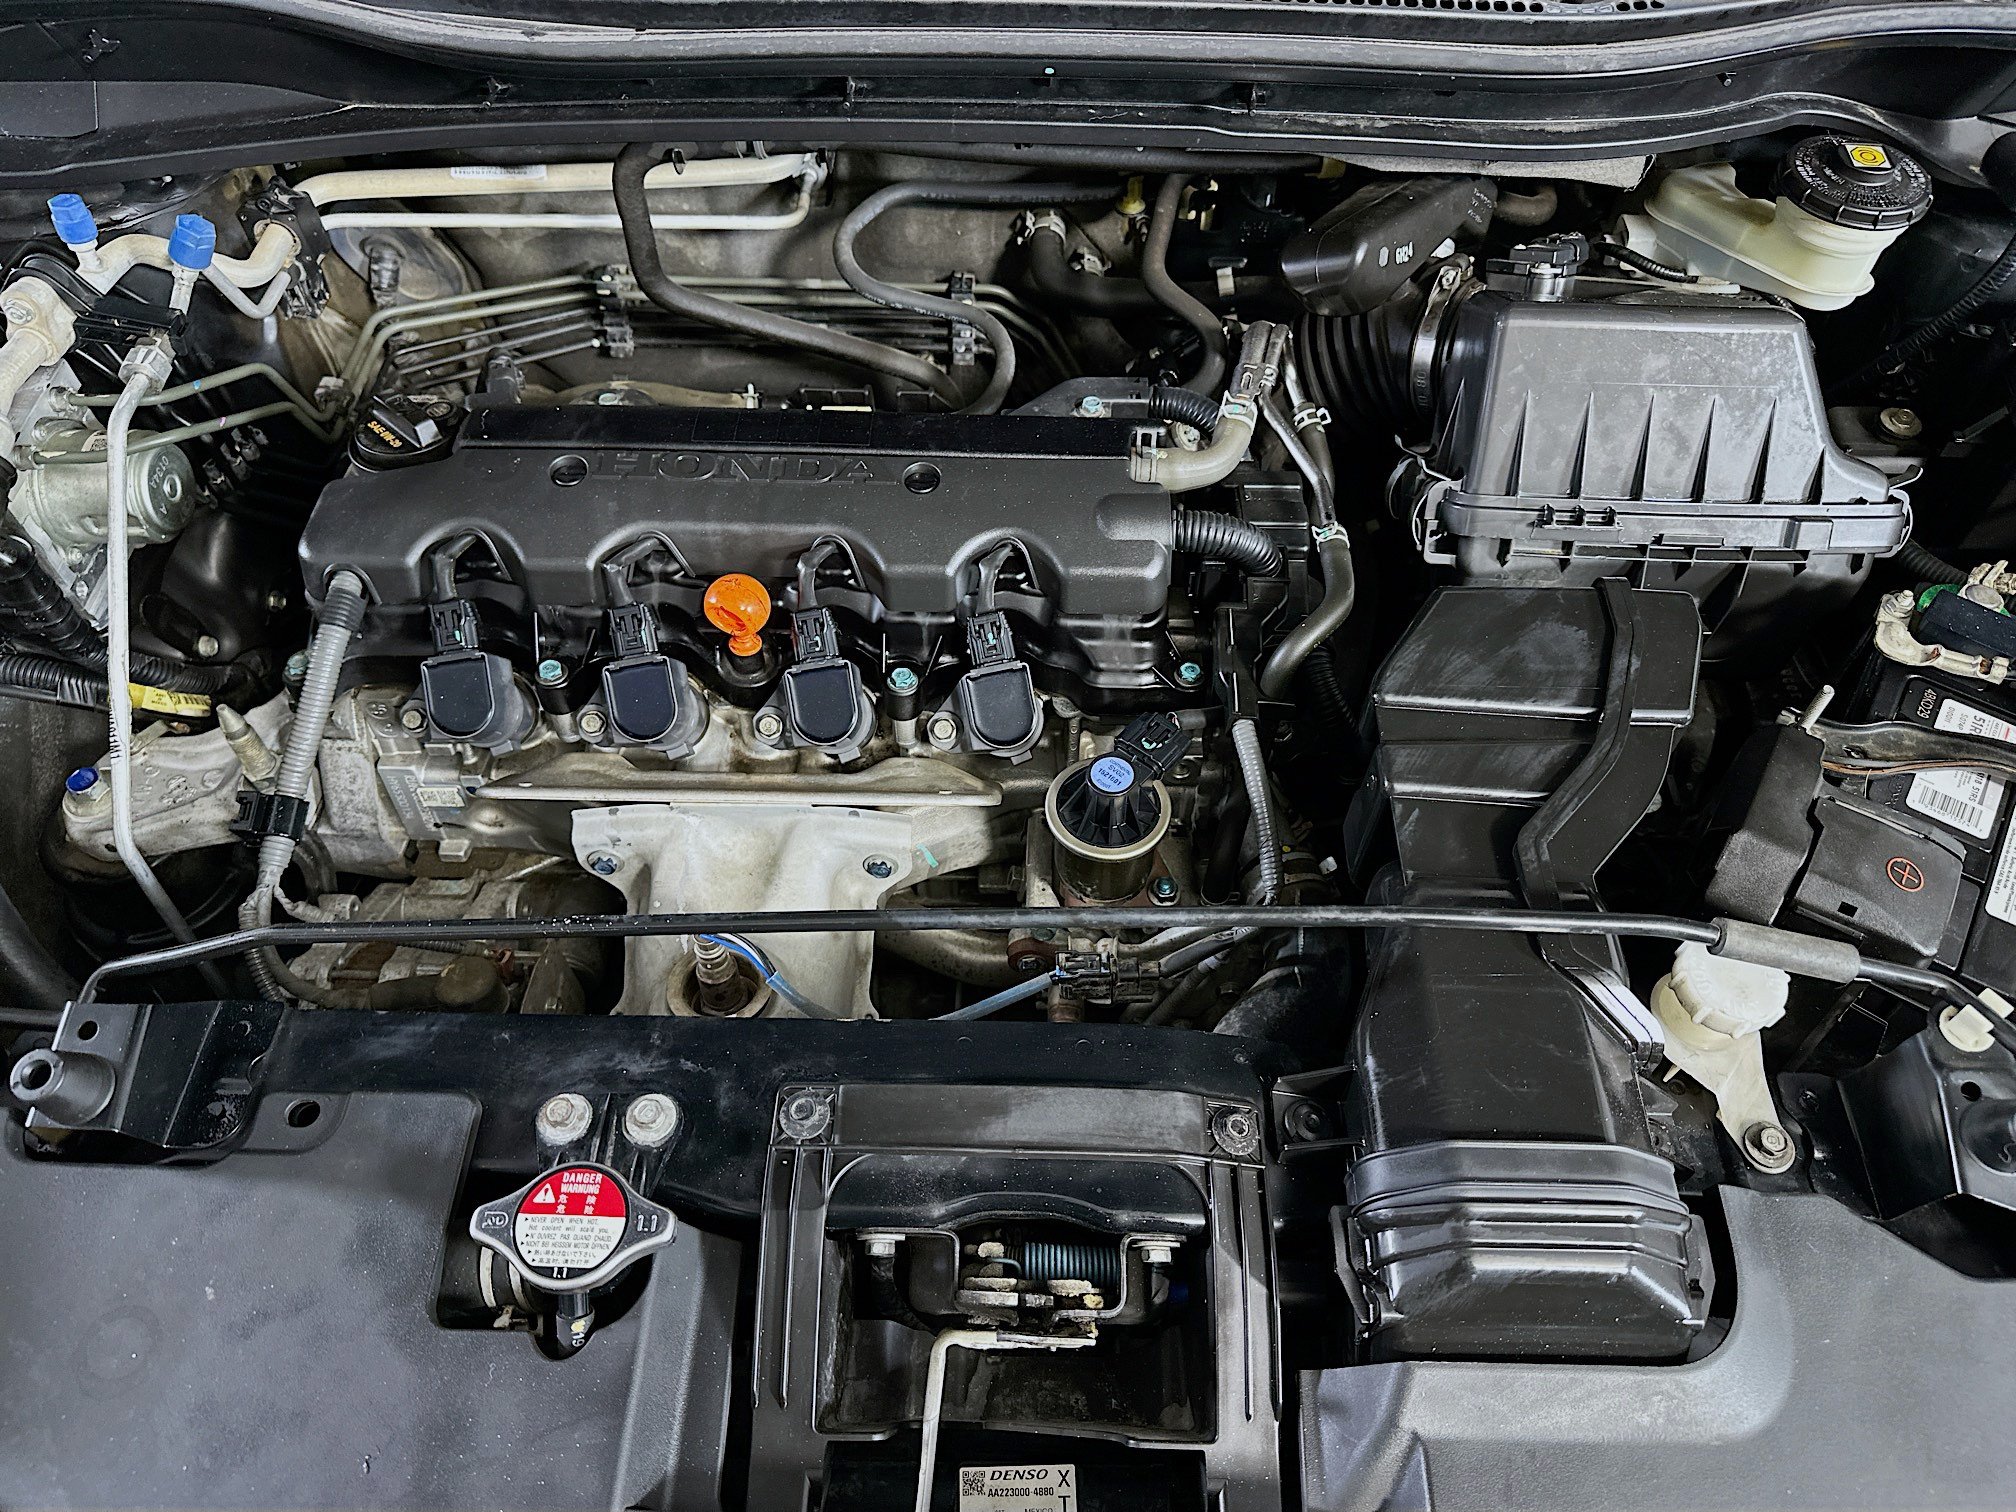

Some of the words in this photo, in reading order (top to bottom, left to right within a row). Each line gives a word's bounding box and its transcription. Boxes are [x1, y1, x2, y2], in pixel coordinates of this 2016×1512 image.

[590, 452, 897, 484] HONDA
[1970, 716, 1986, 734] 51R
[562, 1172, 603, 1184] DANGER
[561, 1183, 600, 1194] WARNUNG
[530, 1216, 547, 1224] NEVER
[636, 1214, 658, 1232] 1.1
[552, 1267, 568, 1279] 1.1
[990, 1469, 1048, 1481] DENSO
[1058, 1469, 1071, 1487] X
[987, 1487, 1054, 1497] AA223000-4880
